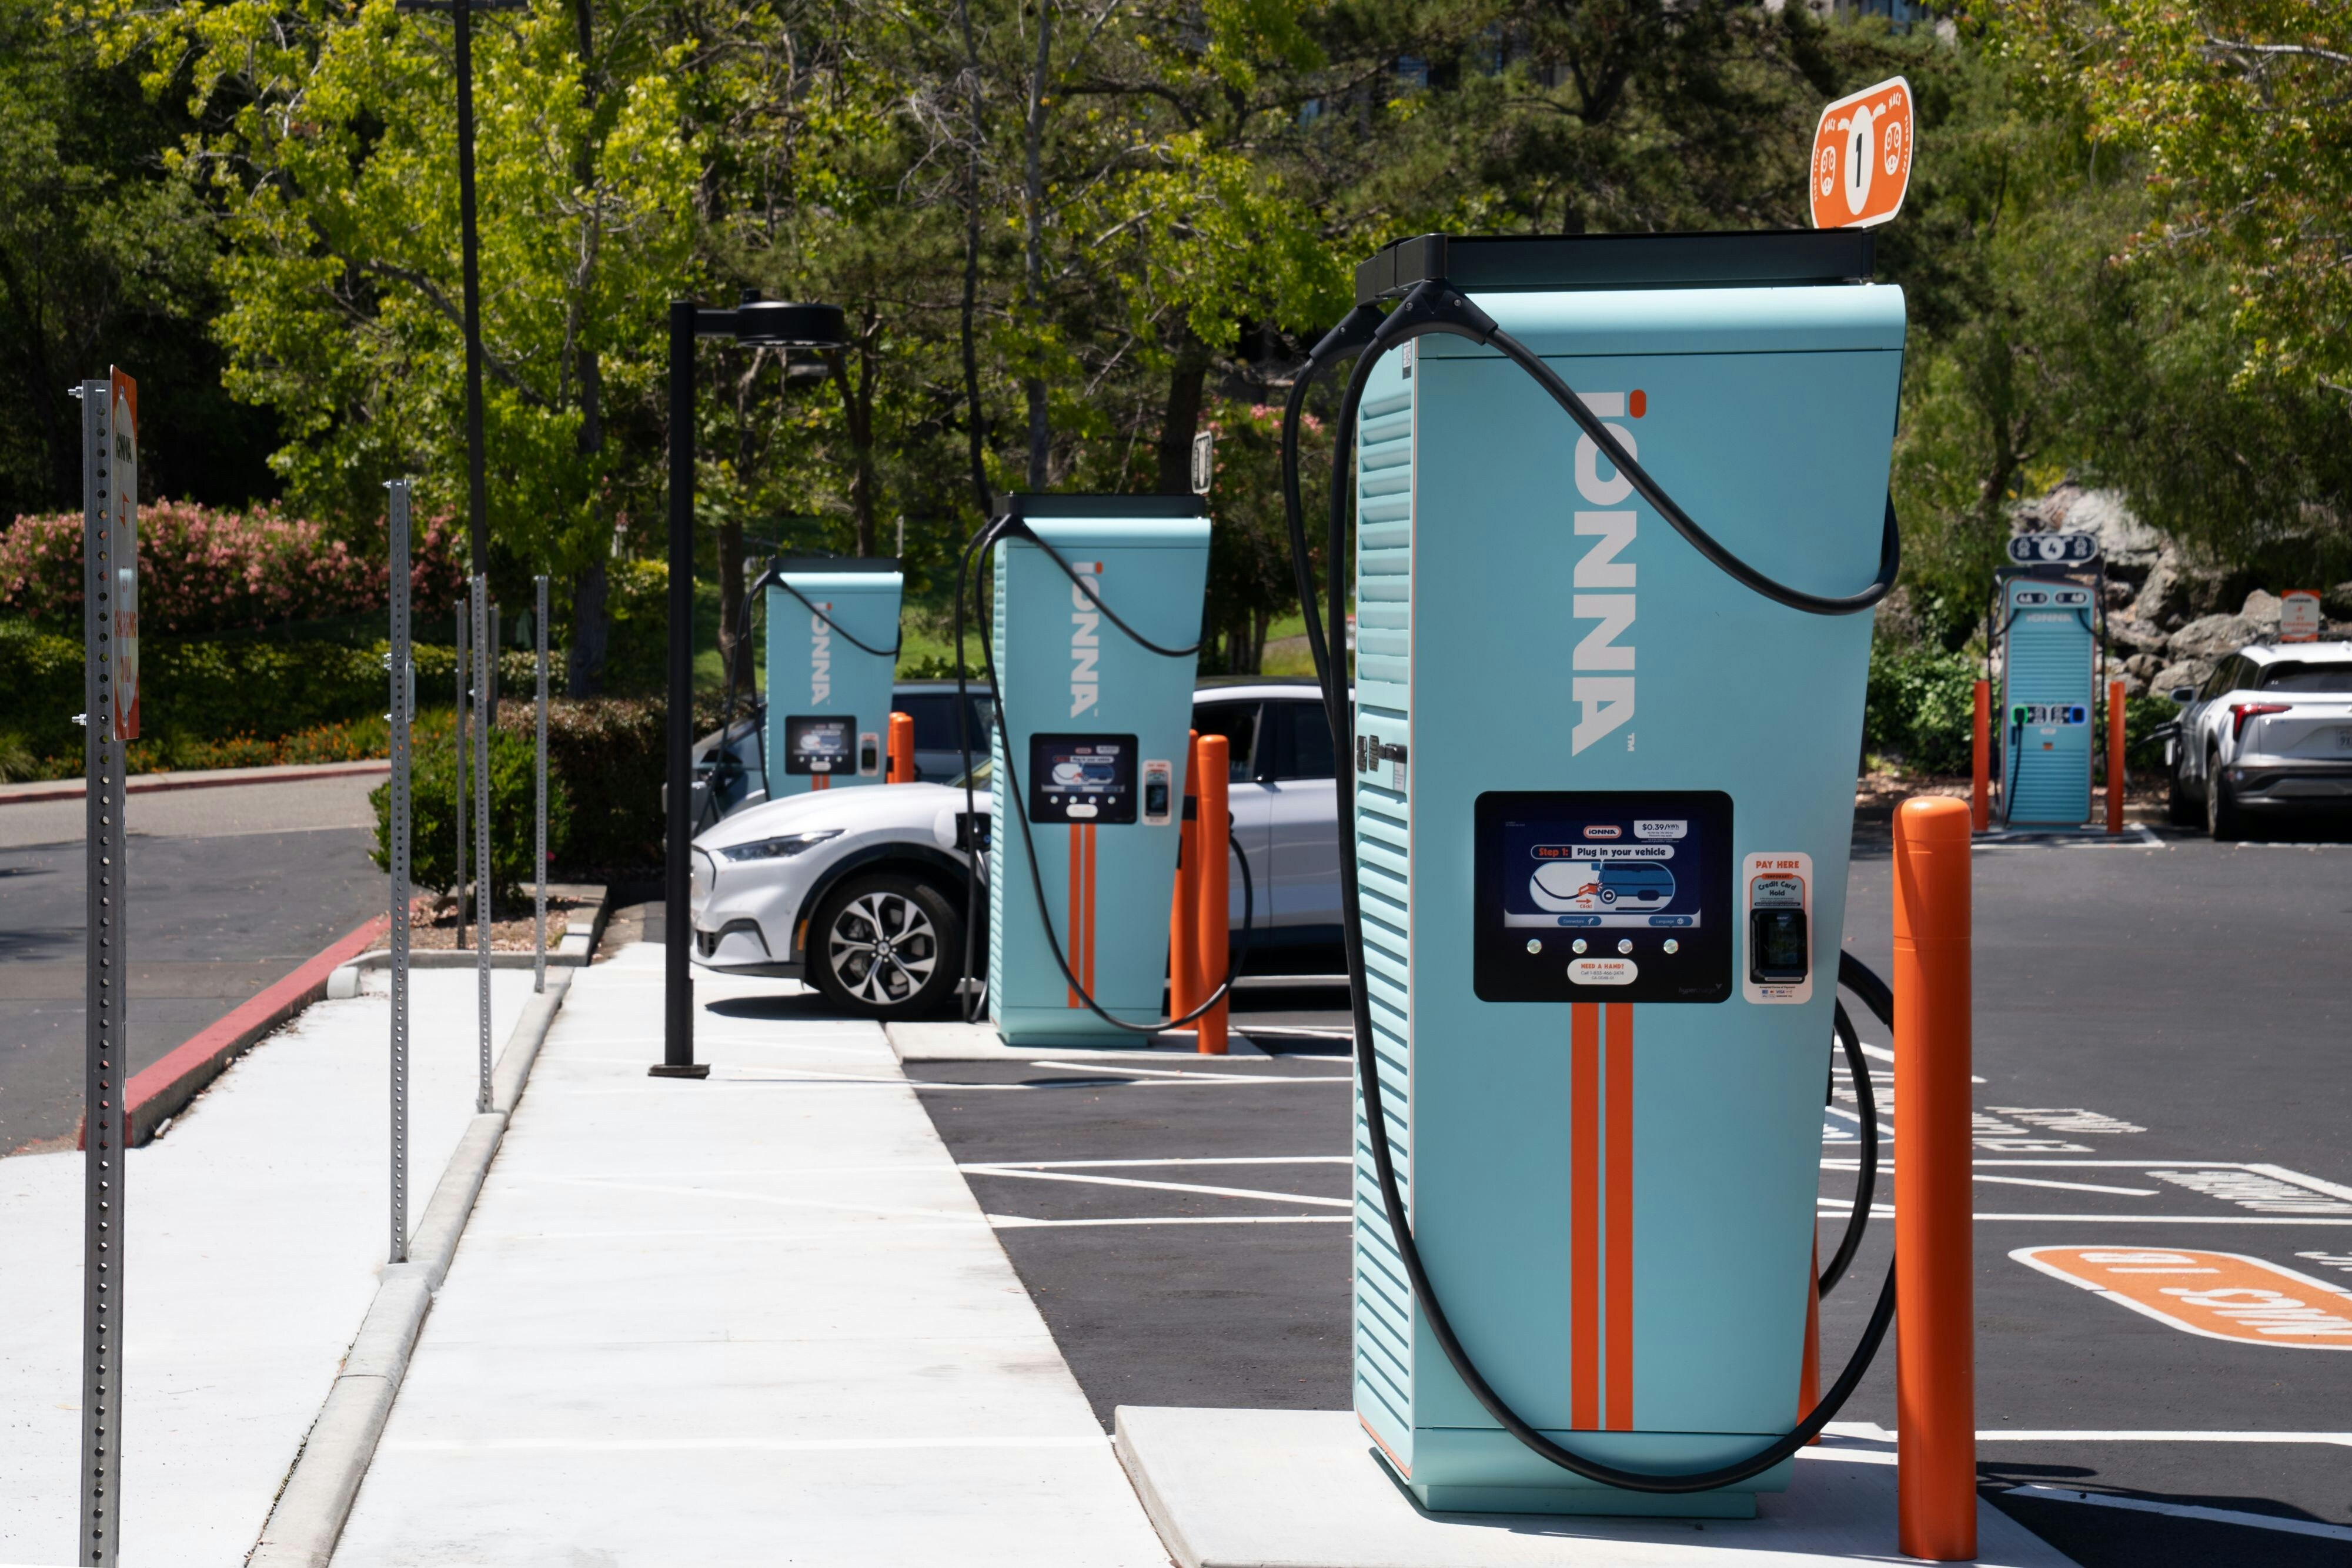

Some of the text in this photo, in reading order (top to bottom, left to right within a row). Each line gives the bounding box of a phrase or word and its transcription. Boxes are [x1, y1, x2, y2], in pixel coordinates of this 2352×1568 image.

[1889, 92, 1902, 110] NACS
[1824, 118, 1836, 135] NACS
[1856, 133, 1863, 188] 1
[115, 610, 136, 638] CHARGING
[120, 656, 132, 683] ONLY
[1538, 847, 1666, 857] Step 1: Plug in your vehicle
[1756, 860, 1799, 869] PAY HERE
[1758, 881, 1797, 890] Credit Card
